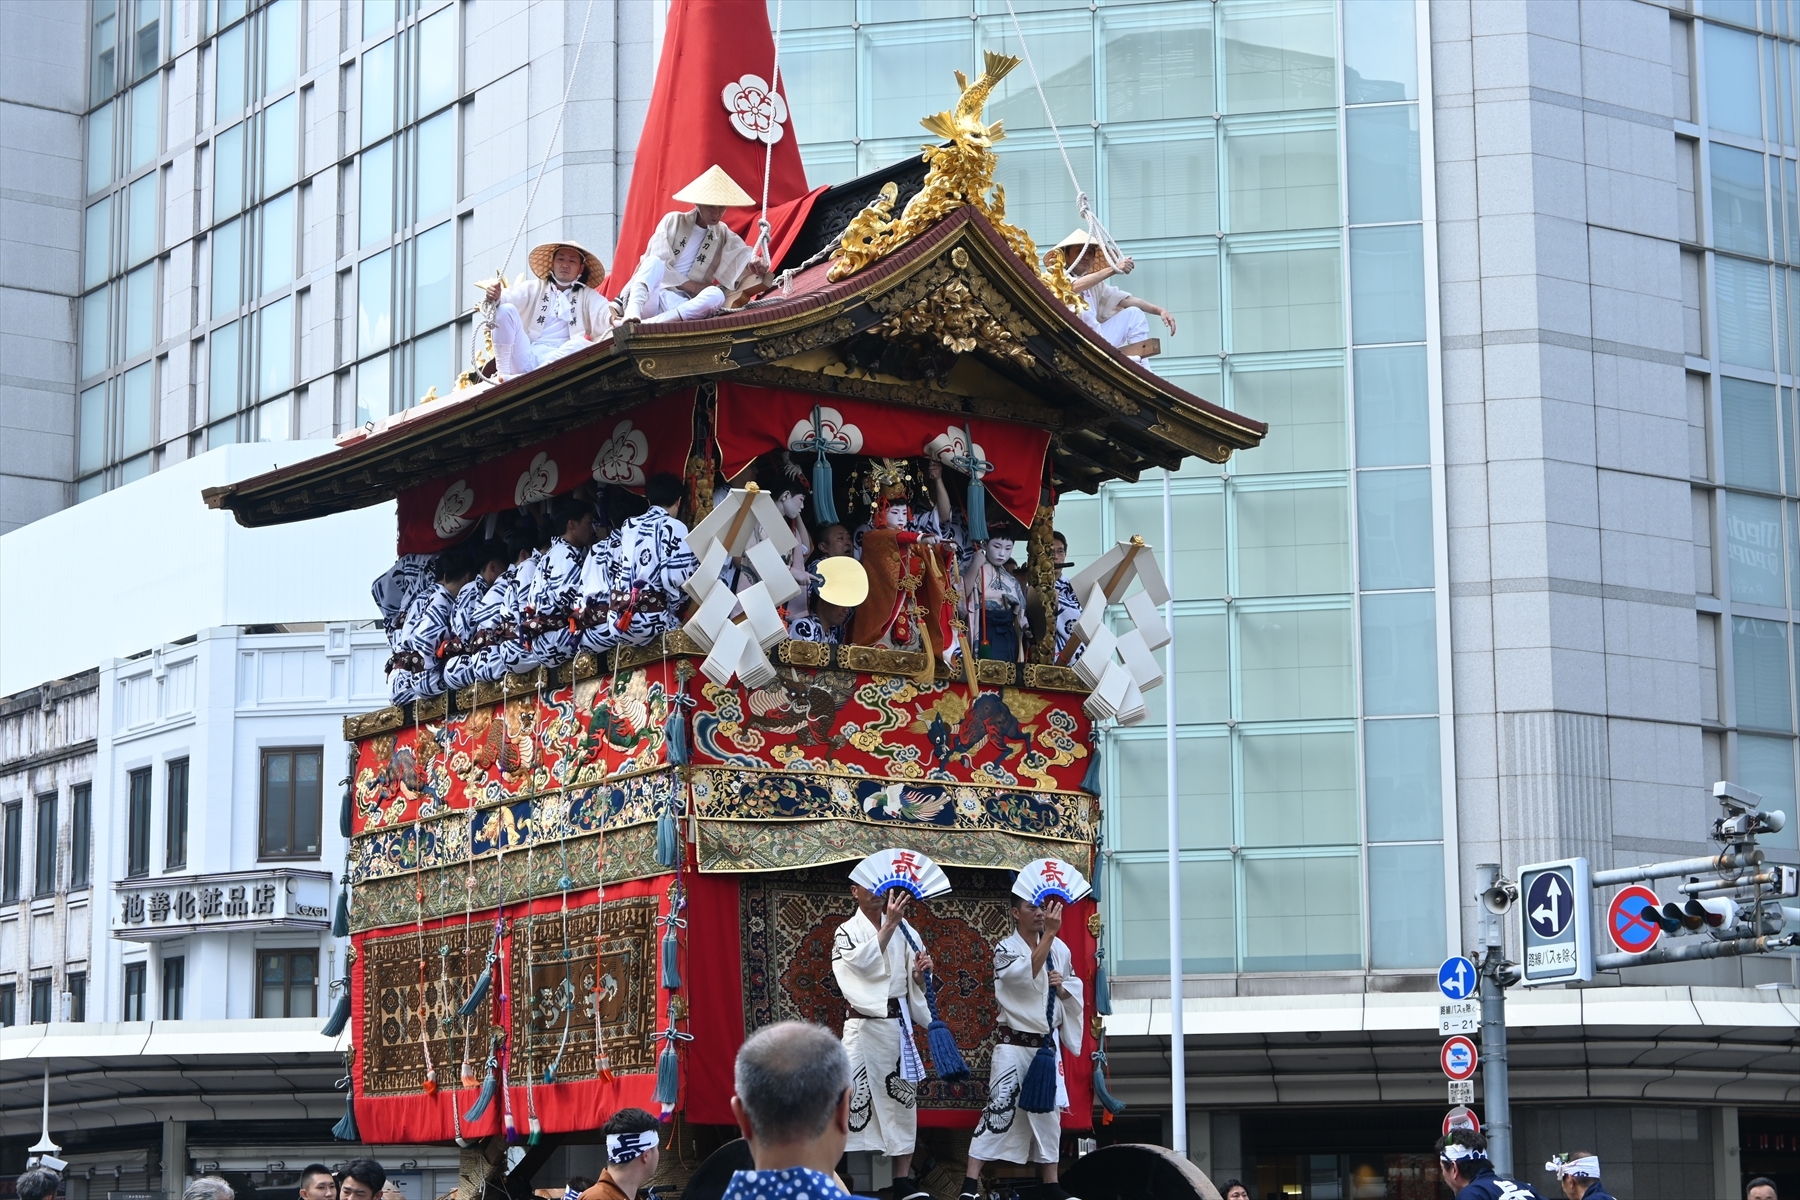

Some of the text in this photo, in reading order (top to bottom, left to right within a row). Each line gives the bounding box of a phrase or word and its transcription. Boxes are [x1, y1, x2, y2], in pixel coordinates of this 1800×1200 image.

[121, 883, 276, 925] 池善化粧品店
[1528, 948, 1576, 967] 路線バスを除く
[1440, 1003, 1476, 1016] 路線バスを除く
